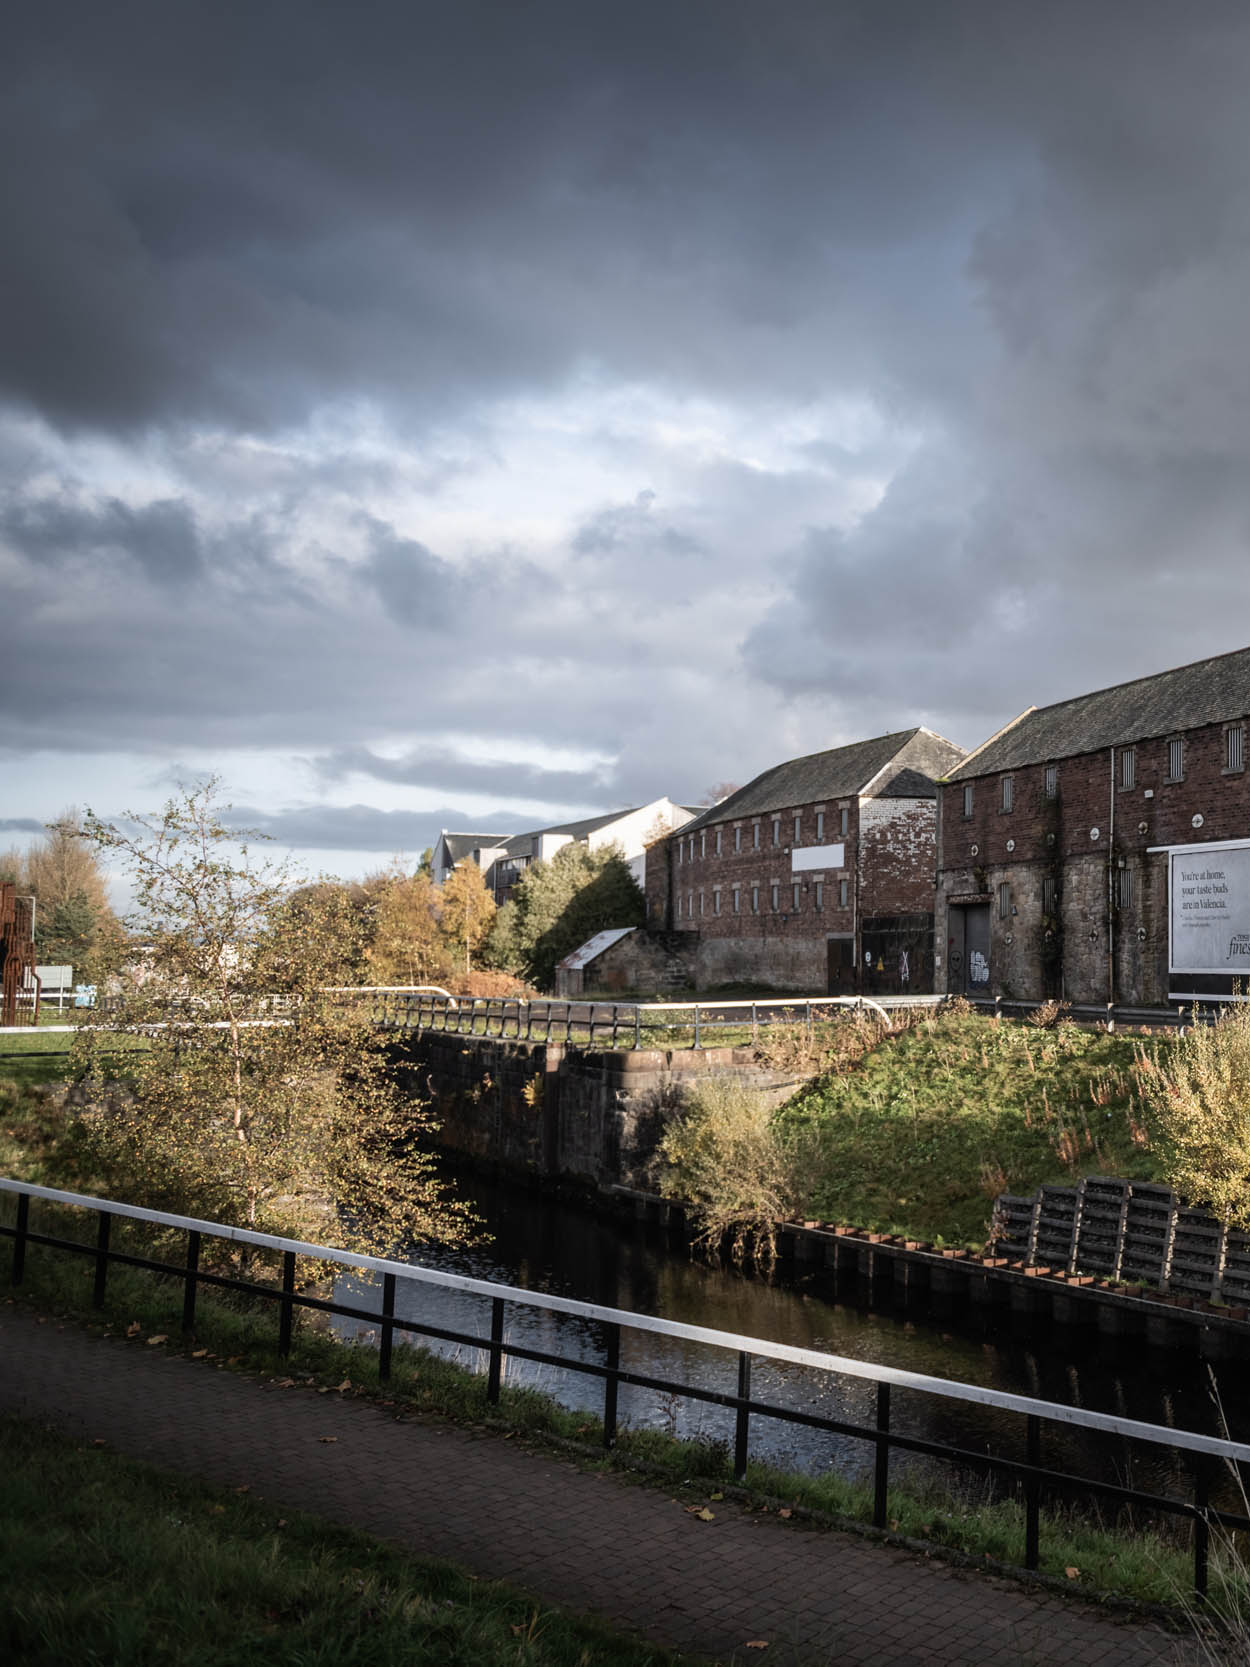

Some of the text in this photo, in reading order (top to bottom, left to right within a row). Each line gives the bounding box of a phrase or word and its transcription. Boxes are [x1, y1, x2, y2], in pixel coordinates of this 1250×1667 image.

[1181, 869, 1226, 881] You're at home,
[1182, 883, 1229, 898] your taste buds
[1182, 902, 1193, 910] are
